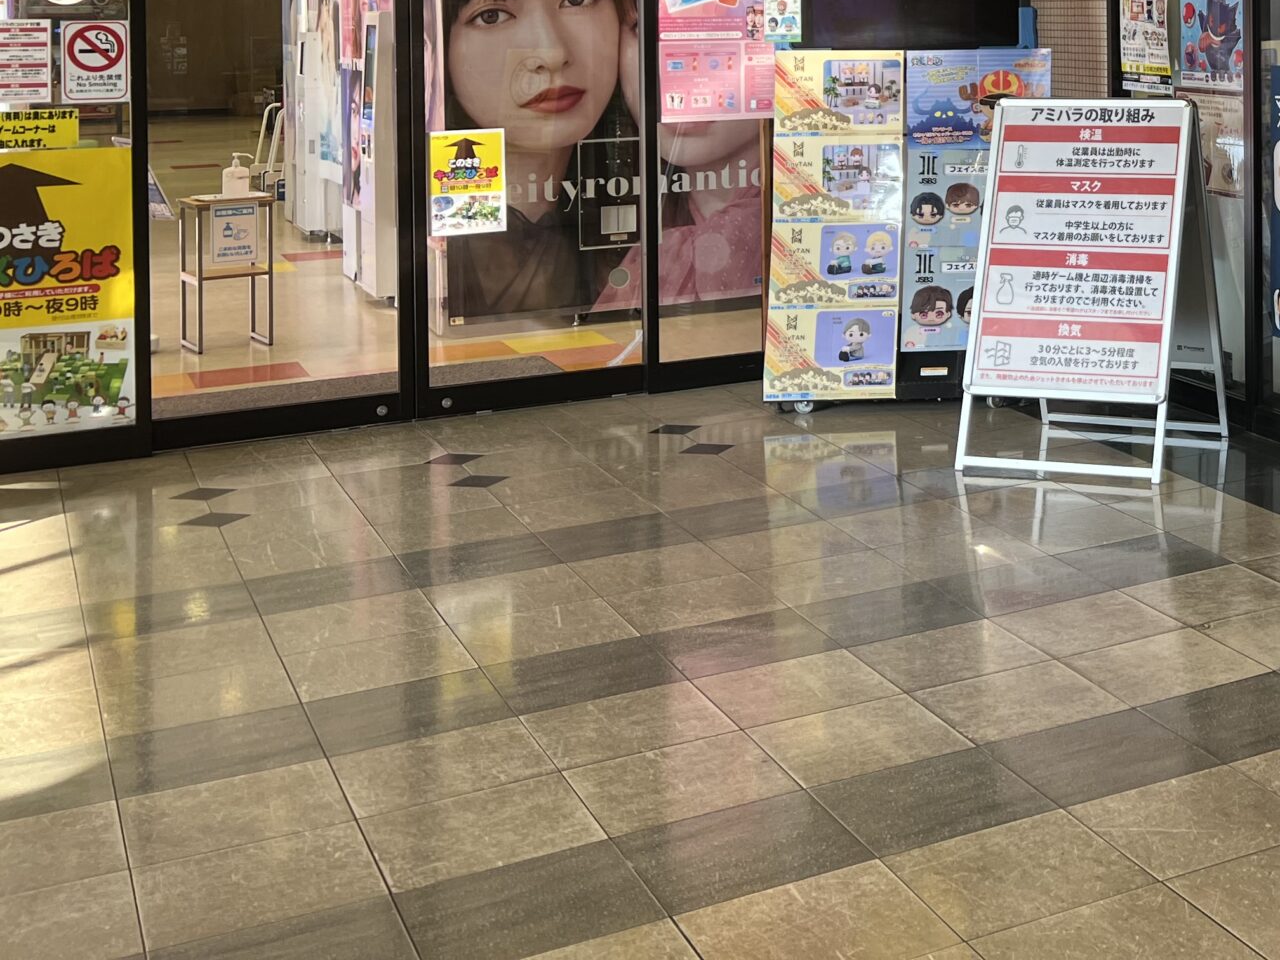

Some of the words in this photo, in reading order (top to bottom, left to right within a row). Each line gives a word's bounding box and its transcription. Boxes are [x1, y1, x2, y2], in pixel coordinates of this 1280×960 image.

[1031, 107, 1155, 124] アミパラの取り組み
[0, 125, 56, 134] ームコーナーは
[1079, 128, 1103, 141] 検温
[1072, 146, 1141, 157] 従業員は出勤時に
[1056, 158, 1156, 169] 体温測定を行っております
[1070, 181, 1101, 192] マスク
[1036, 199, 1168, 211] 従業員はマスクを着用しております
[1065, 221, 1134, 231] 中学生以上の方に
[1033, 232, 1165, 244] マスク着用のお願いをしております
[1065, 252, 1089, 266] 消毒
[0, 245, 121, 287] ひろば
[0, 296, 99, 317] 時〜夜9時
[1033, 294, 1147, 309] おりますのでご利用ください。
[1057, 323, 1082, 337] 換気
[1029, 356, 1140, 370] 空気の入替を行っております
